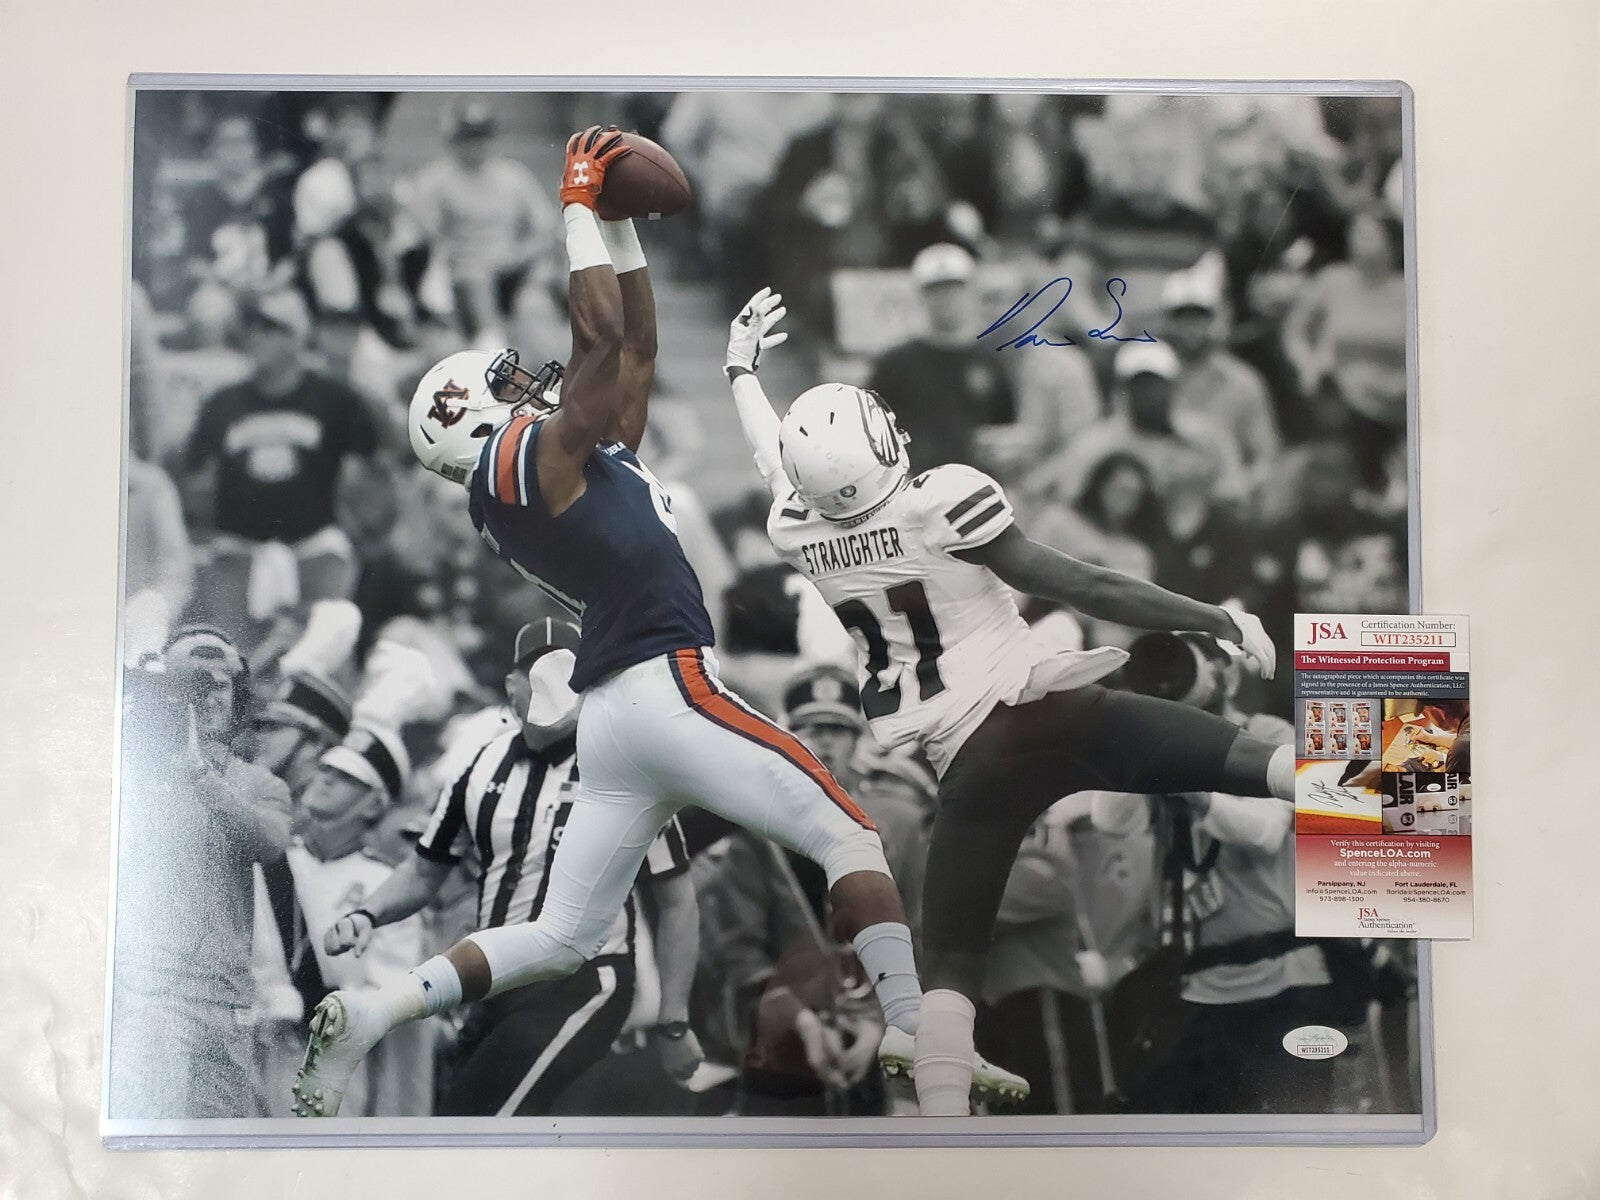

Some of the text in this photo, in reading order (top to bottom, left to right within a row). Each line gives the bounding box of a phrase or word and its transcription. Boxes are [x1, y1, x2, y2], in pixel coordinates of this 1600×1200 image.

[801, 526, 907, 576] STRAUGHTER
[1361, 620, 1456, 630] Certification Number:
[1307, 621, 1349, 645] JSA
[1373, 633, 1443, 645] WIT235211
[1301, 655, 1445, 667] The Witnessed Protection Program
[1330, 840, 1350, 848] Verify
[1365, 840, 1405, 848] certification
[1407, 840, 1415, 849] by
[1416, 840, 1440, 849] visiting
[1340, 848, 1431, 859] SpenceLOA.com
[1348, 860, 1375, 868] entering
[1389, 860, 1437, 869] alpha-numeric
[1349, 869, 1367, 877] value
[1368, 869, 1399, 877] indicated
[1357, 907, 1379, 920] JSA
